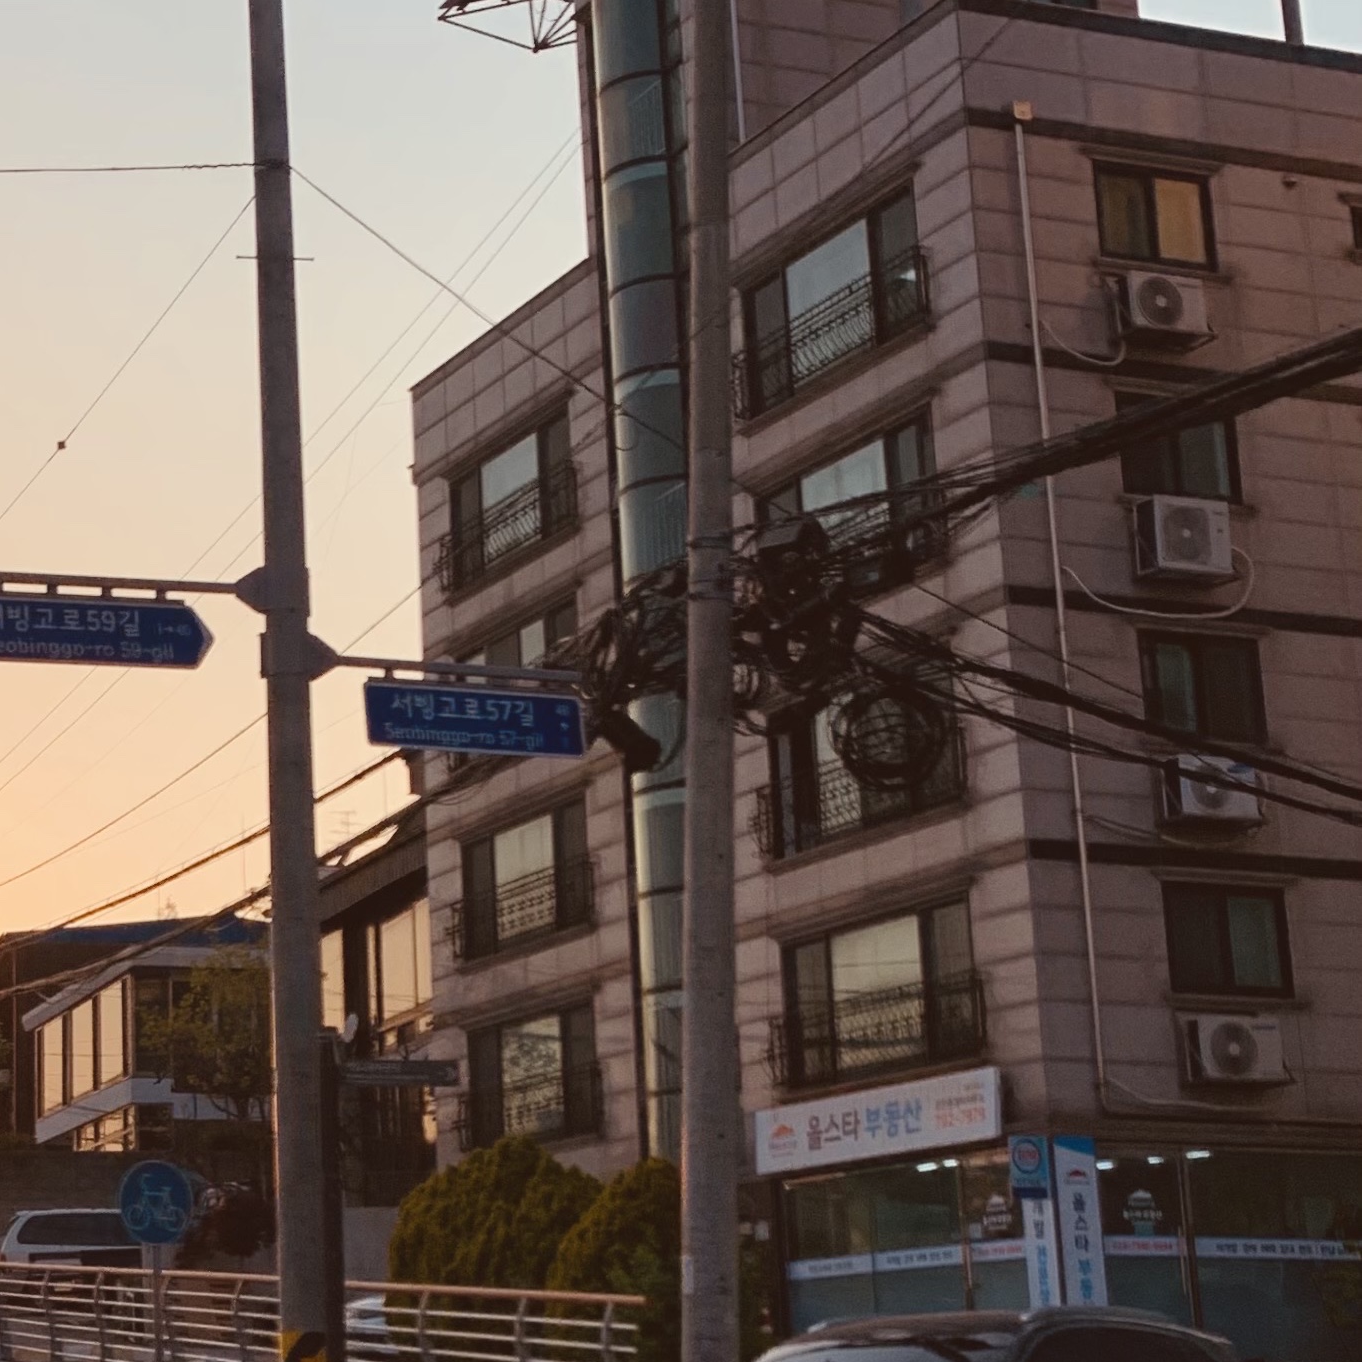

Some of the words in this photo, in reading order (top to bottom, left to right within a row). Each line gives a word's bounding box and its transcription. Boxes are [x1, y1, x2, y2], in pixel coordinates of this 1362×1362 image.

[391, 693, 534, 727] 서빙고로57길
[806, 1109, 861, 1151] 올스타
[864, 1097, 923, 1138] 부동산
